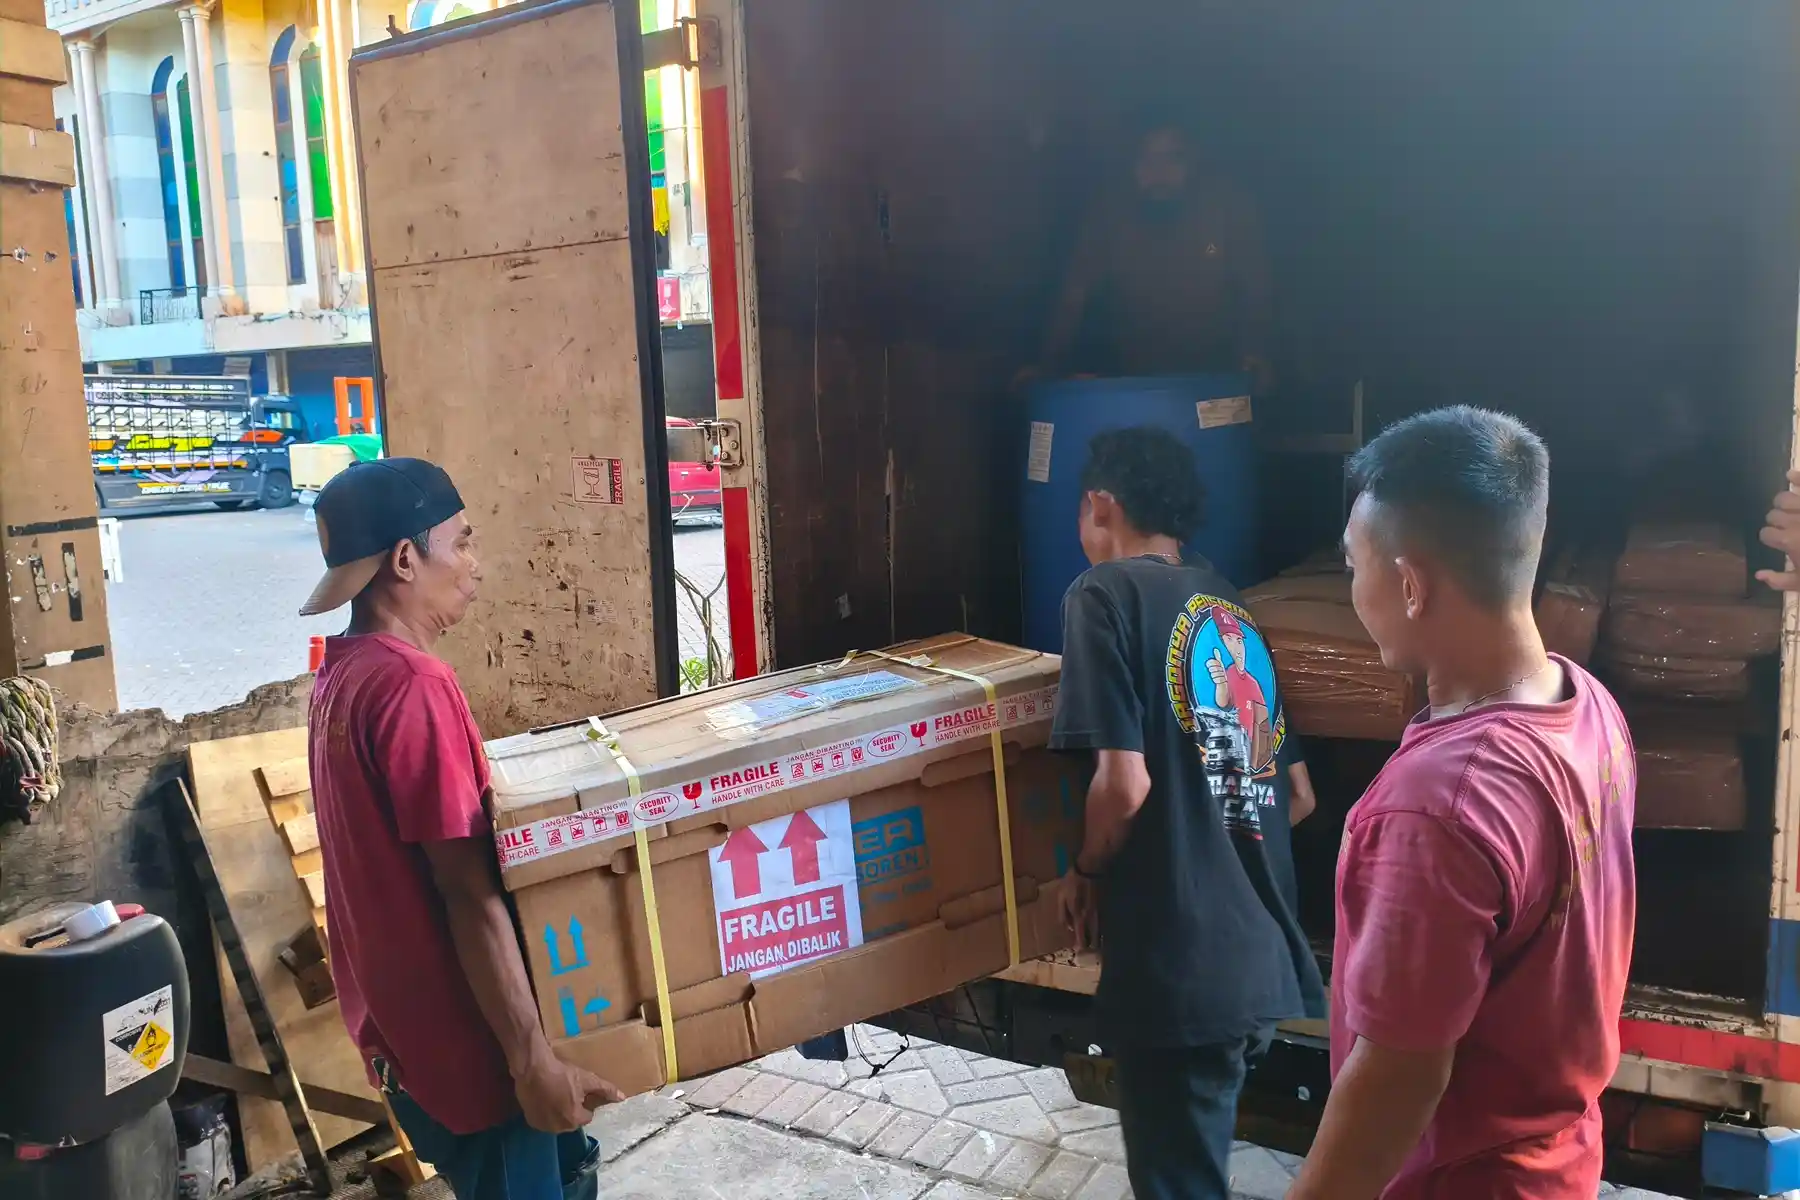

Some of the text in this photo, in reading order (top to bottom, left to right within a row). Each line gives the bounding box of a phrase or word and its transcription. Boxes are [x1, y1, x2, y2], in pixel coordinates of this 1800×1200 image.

[612, 460, 623, 504] FRAGILE
[934, 703, 997, 730] FRAGILE
[872, 733, 901, 748] SECURITY
[934, 719, 1001, 743] HANDLE WITH CARE
[786, 750, 815, 763] JANGAN
[880, 744, 896, 754] SEAL
[710, 761, 780, 791] FRAGILE
[711, 777, 785, 805] HANDLE WITH CARE
[639, 796, 671, 811] SECURITY
[648, 805, 666, 816] SEAL
[540, 816, 572, 829] JANGAN
[517, 846, 540, 858] CARE
[724, 895, 837, 944] FRAGILE
[727, 945, 784, 973] JANGAN
[787, 930, 842, 959] DIBALIK
